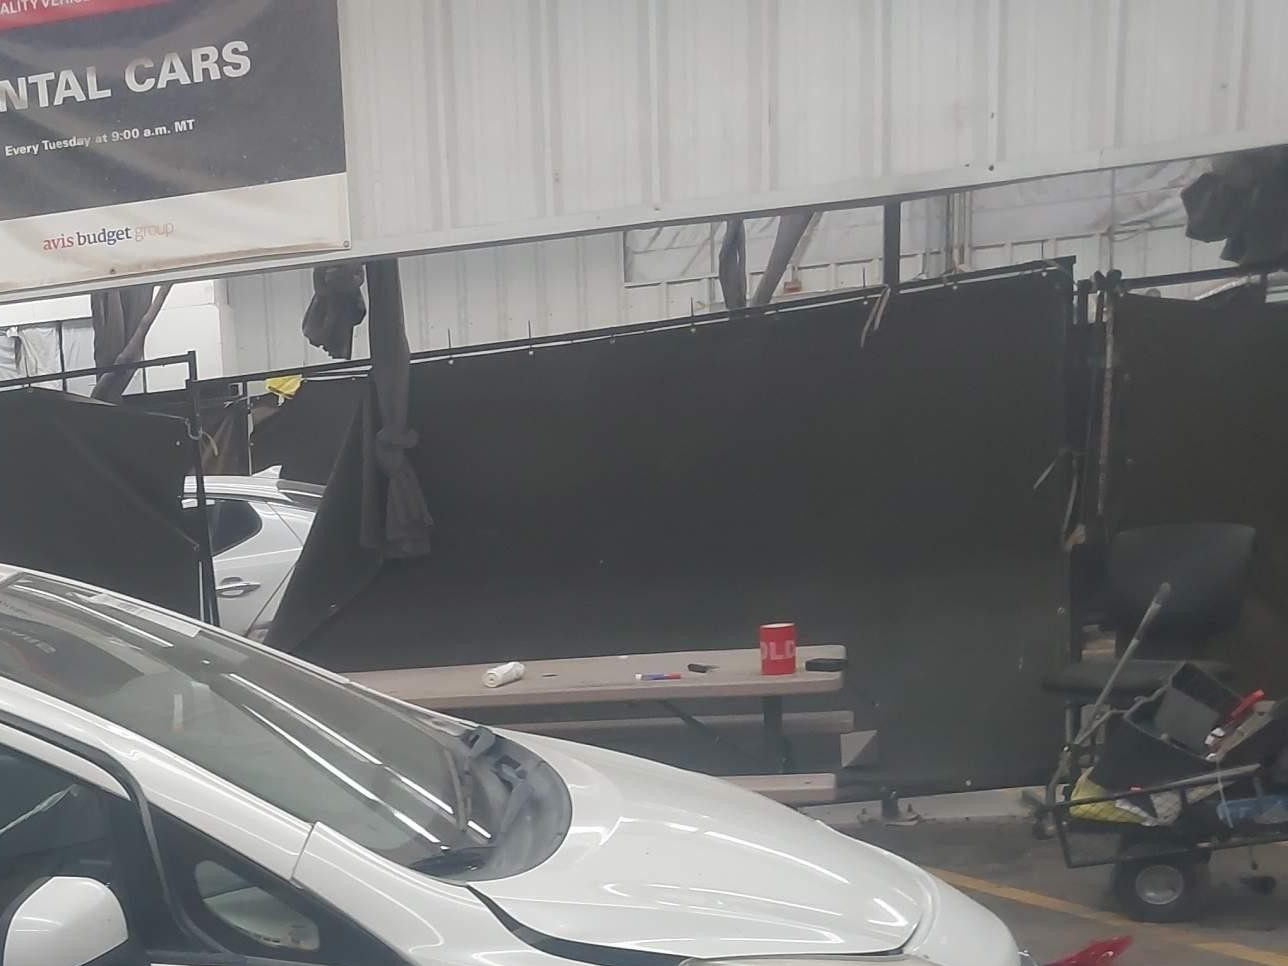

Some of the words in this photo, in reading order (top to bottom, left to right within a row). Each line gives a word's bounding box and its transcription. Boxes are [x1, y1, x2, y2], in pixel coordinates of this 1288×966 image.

[124, 40, 251, 93] CARS
[4, 142, 39, 157] Every
[41, 135, 91, 151] Tuesday
[95, 133, 108, 144] at
[111, 127, 140, 142] 9:00
[143, 125, 171, 139] a.m.
[174, 118, 196, 133] MT
[42, 233, 74, 251] avis
[76, 226, 132, 246] budget
[134, 222, 175, 242] group
